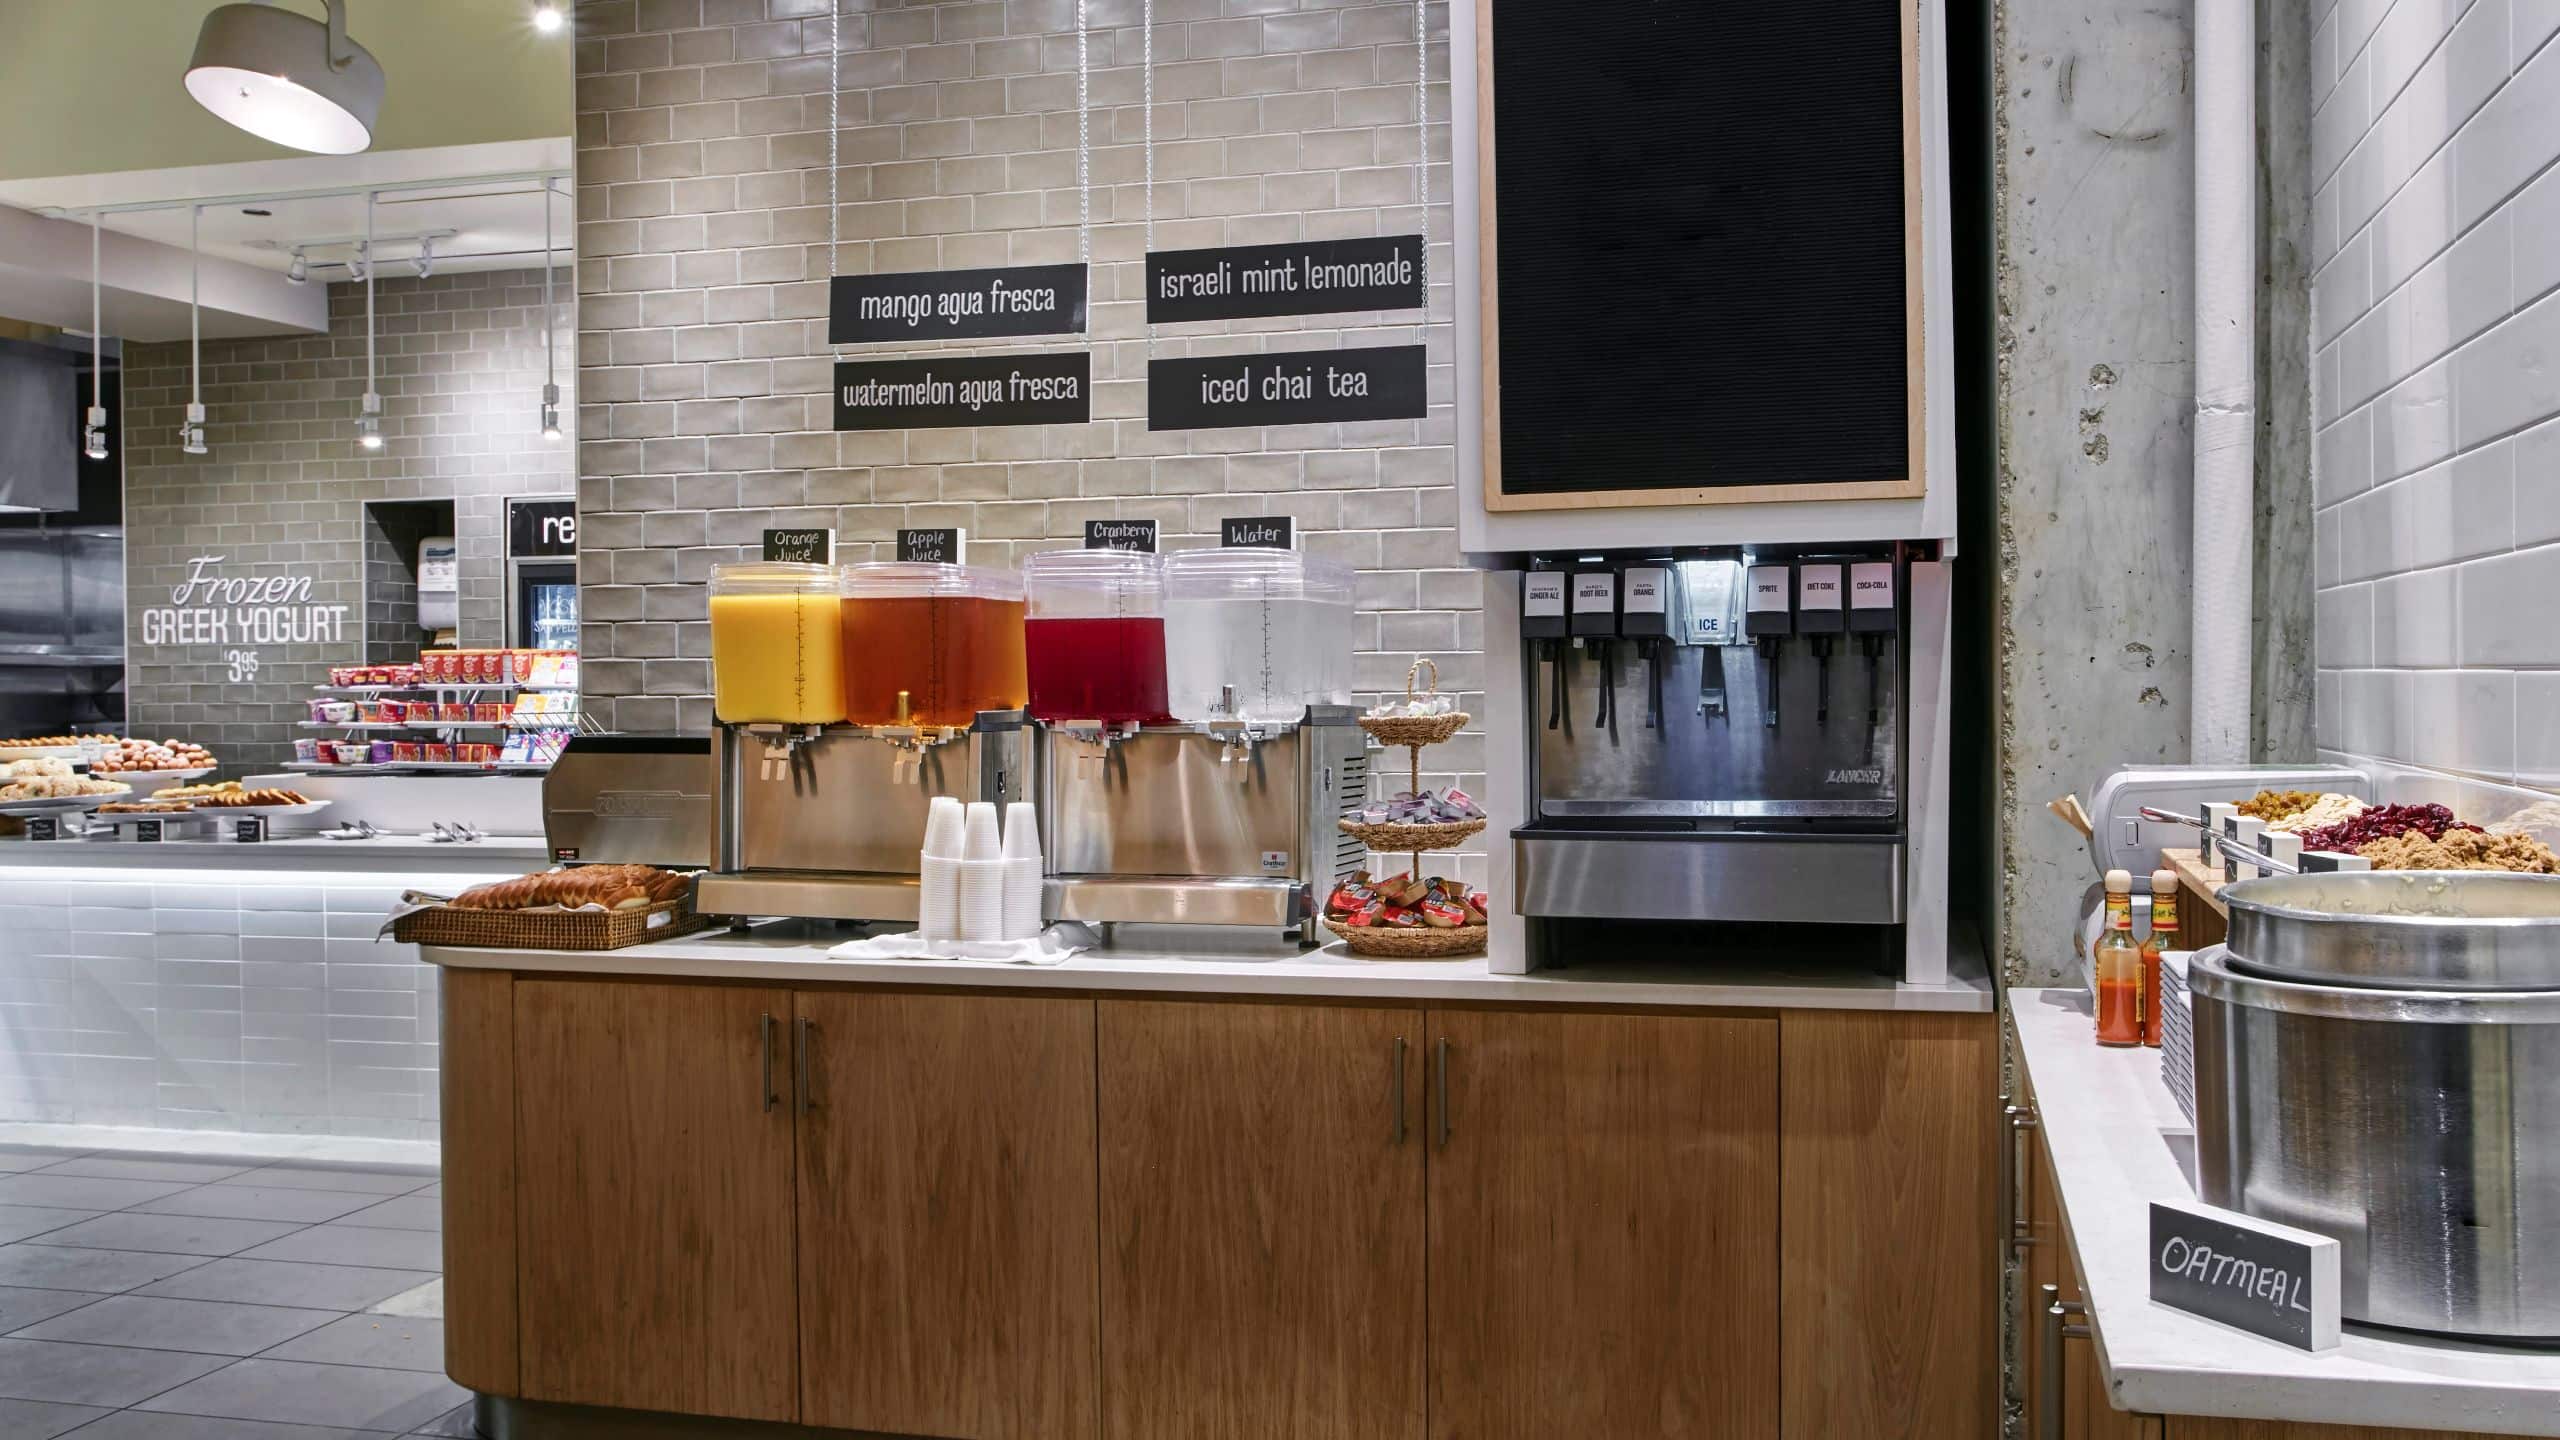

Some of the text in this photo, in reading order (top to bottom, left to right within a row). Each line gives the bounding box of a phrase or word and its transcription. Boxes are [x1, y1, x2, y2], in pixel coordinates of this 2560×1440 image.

[1160, 247, 1412, 299] israeli mint lemonade
[860, 279, 1055, 328] mango agua fresca
[843, 371, 1079, 412] watermelon agua fresca
[1202, 365, 1368, 404] iced chai tea
[542, 515, 576, 544] re
[1093, 522, 1154, 543] Cranberry
[1231, 526, 1282, 544] Water
[774, 531, 820, 551] Orange
[907, 531, 945, 551] Apple
[774, 550, 813, 562] Juice
[907, 550, 942, 562] Juice
[172, 555, 314, 605] Frozen
[1758, 584, 1778, 593] SPRITE
[1807, 582, 1835, 590] DIET COKE
[1856, 581, 1888, 590] COCA-COLA
[1550, 592, 1560, 600] ALE
[1579, 589, 1609, 598] ROOT BEER
[1633, 588, 1655, 596] ORANGE
[143, 606, 349, 645] GREEK YOGURT
[1699, 618, 1718, 631] ICE
[2161, 1236, 2311, 1313] OATMEAL
